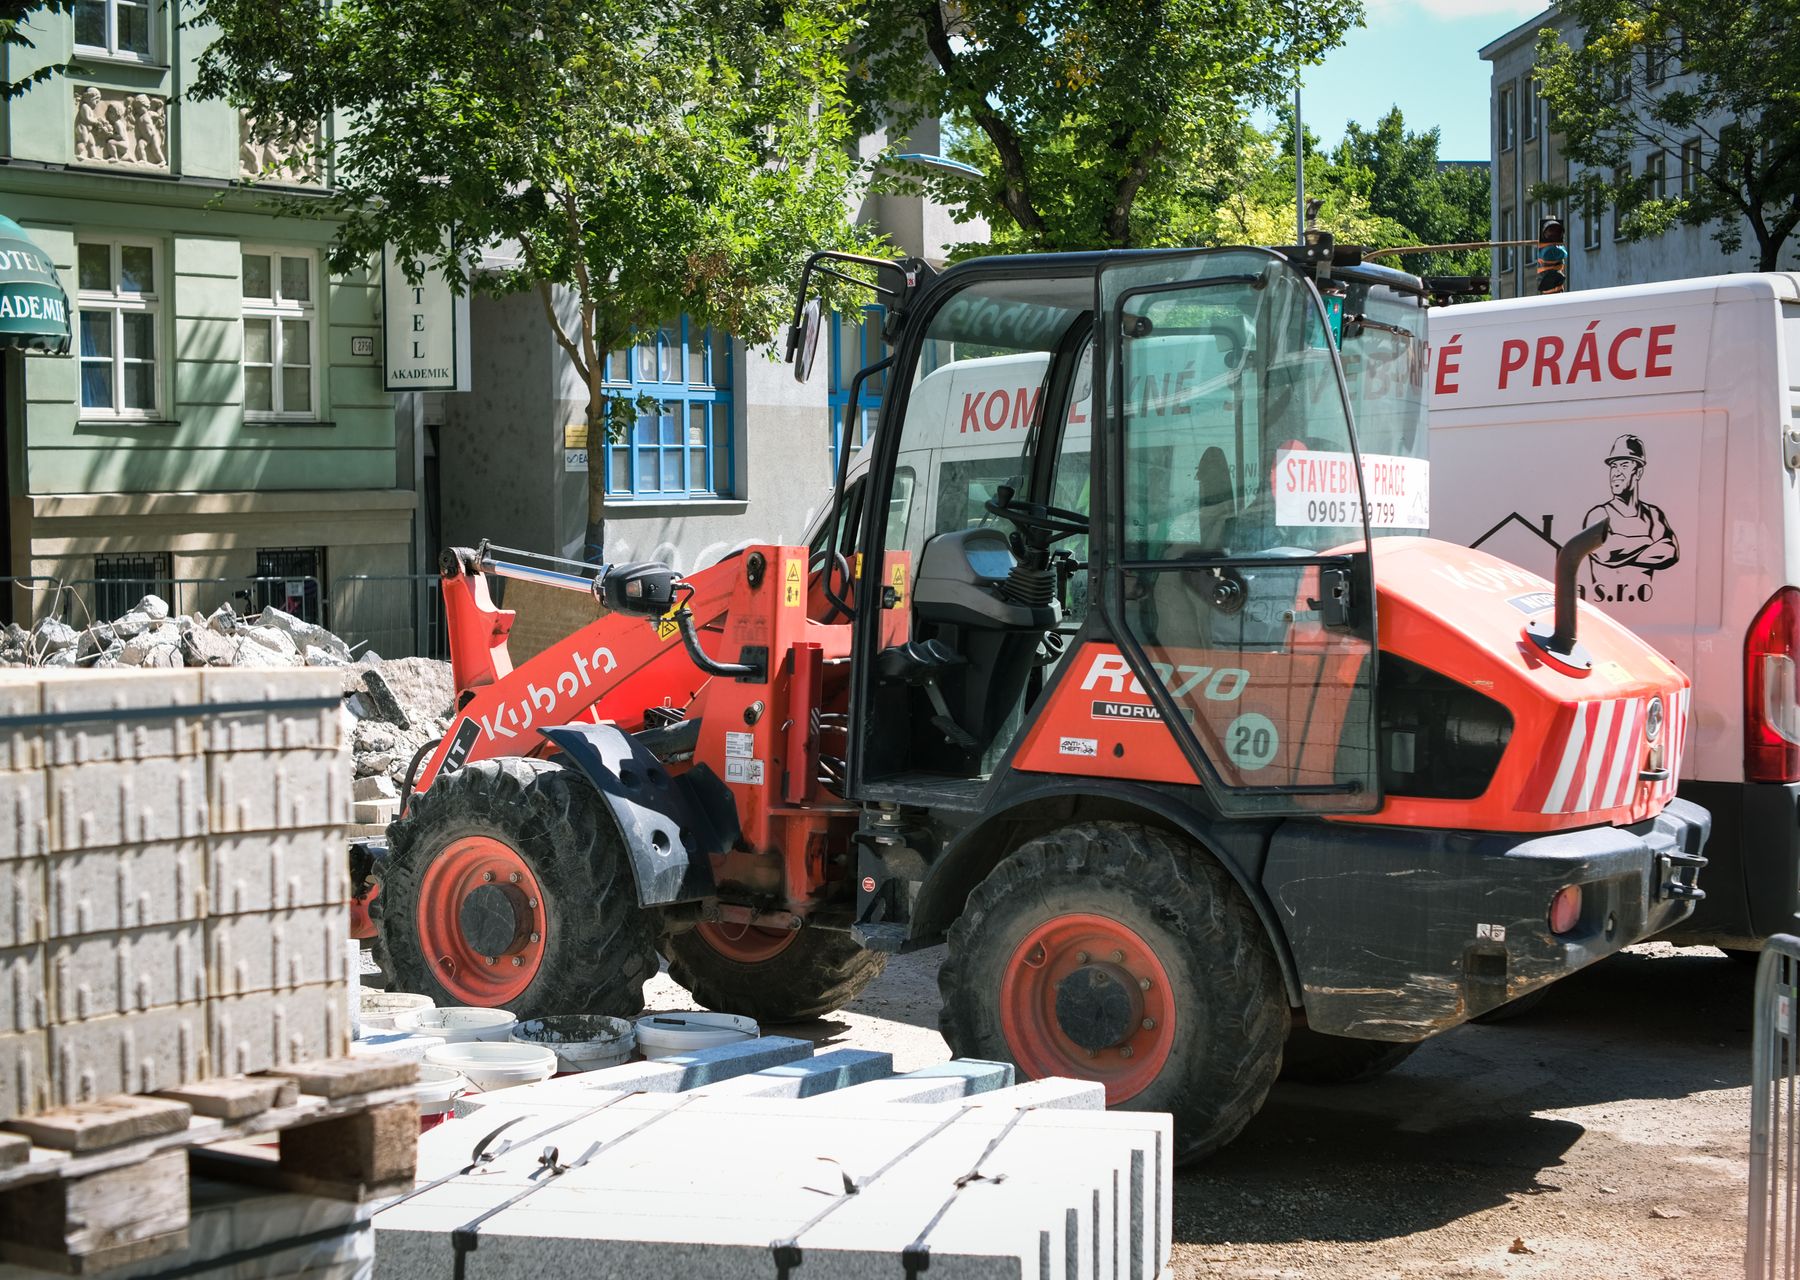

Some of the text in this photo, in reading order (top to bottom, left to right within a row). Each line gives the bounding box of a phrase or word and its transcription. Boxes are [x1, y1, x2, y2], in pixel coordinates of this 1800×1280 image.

[411, 259, 426, 359] OTEL
[1498, 320, 1676, 389] PRÁCE
[392, 368, 449, 380] AKADEMIK
[1374, 459, 1405, 497] PRÁCE
[1308, 500, 1346, 523] 0905
[1377, 503, 1395, 524] 799
[1594, 583, 1654, 603] s.r.o
[480, 647, 618, 741] Kubota
[1233, 726, 1271, 758] 20
